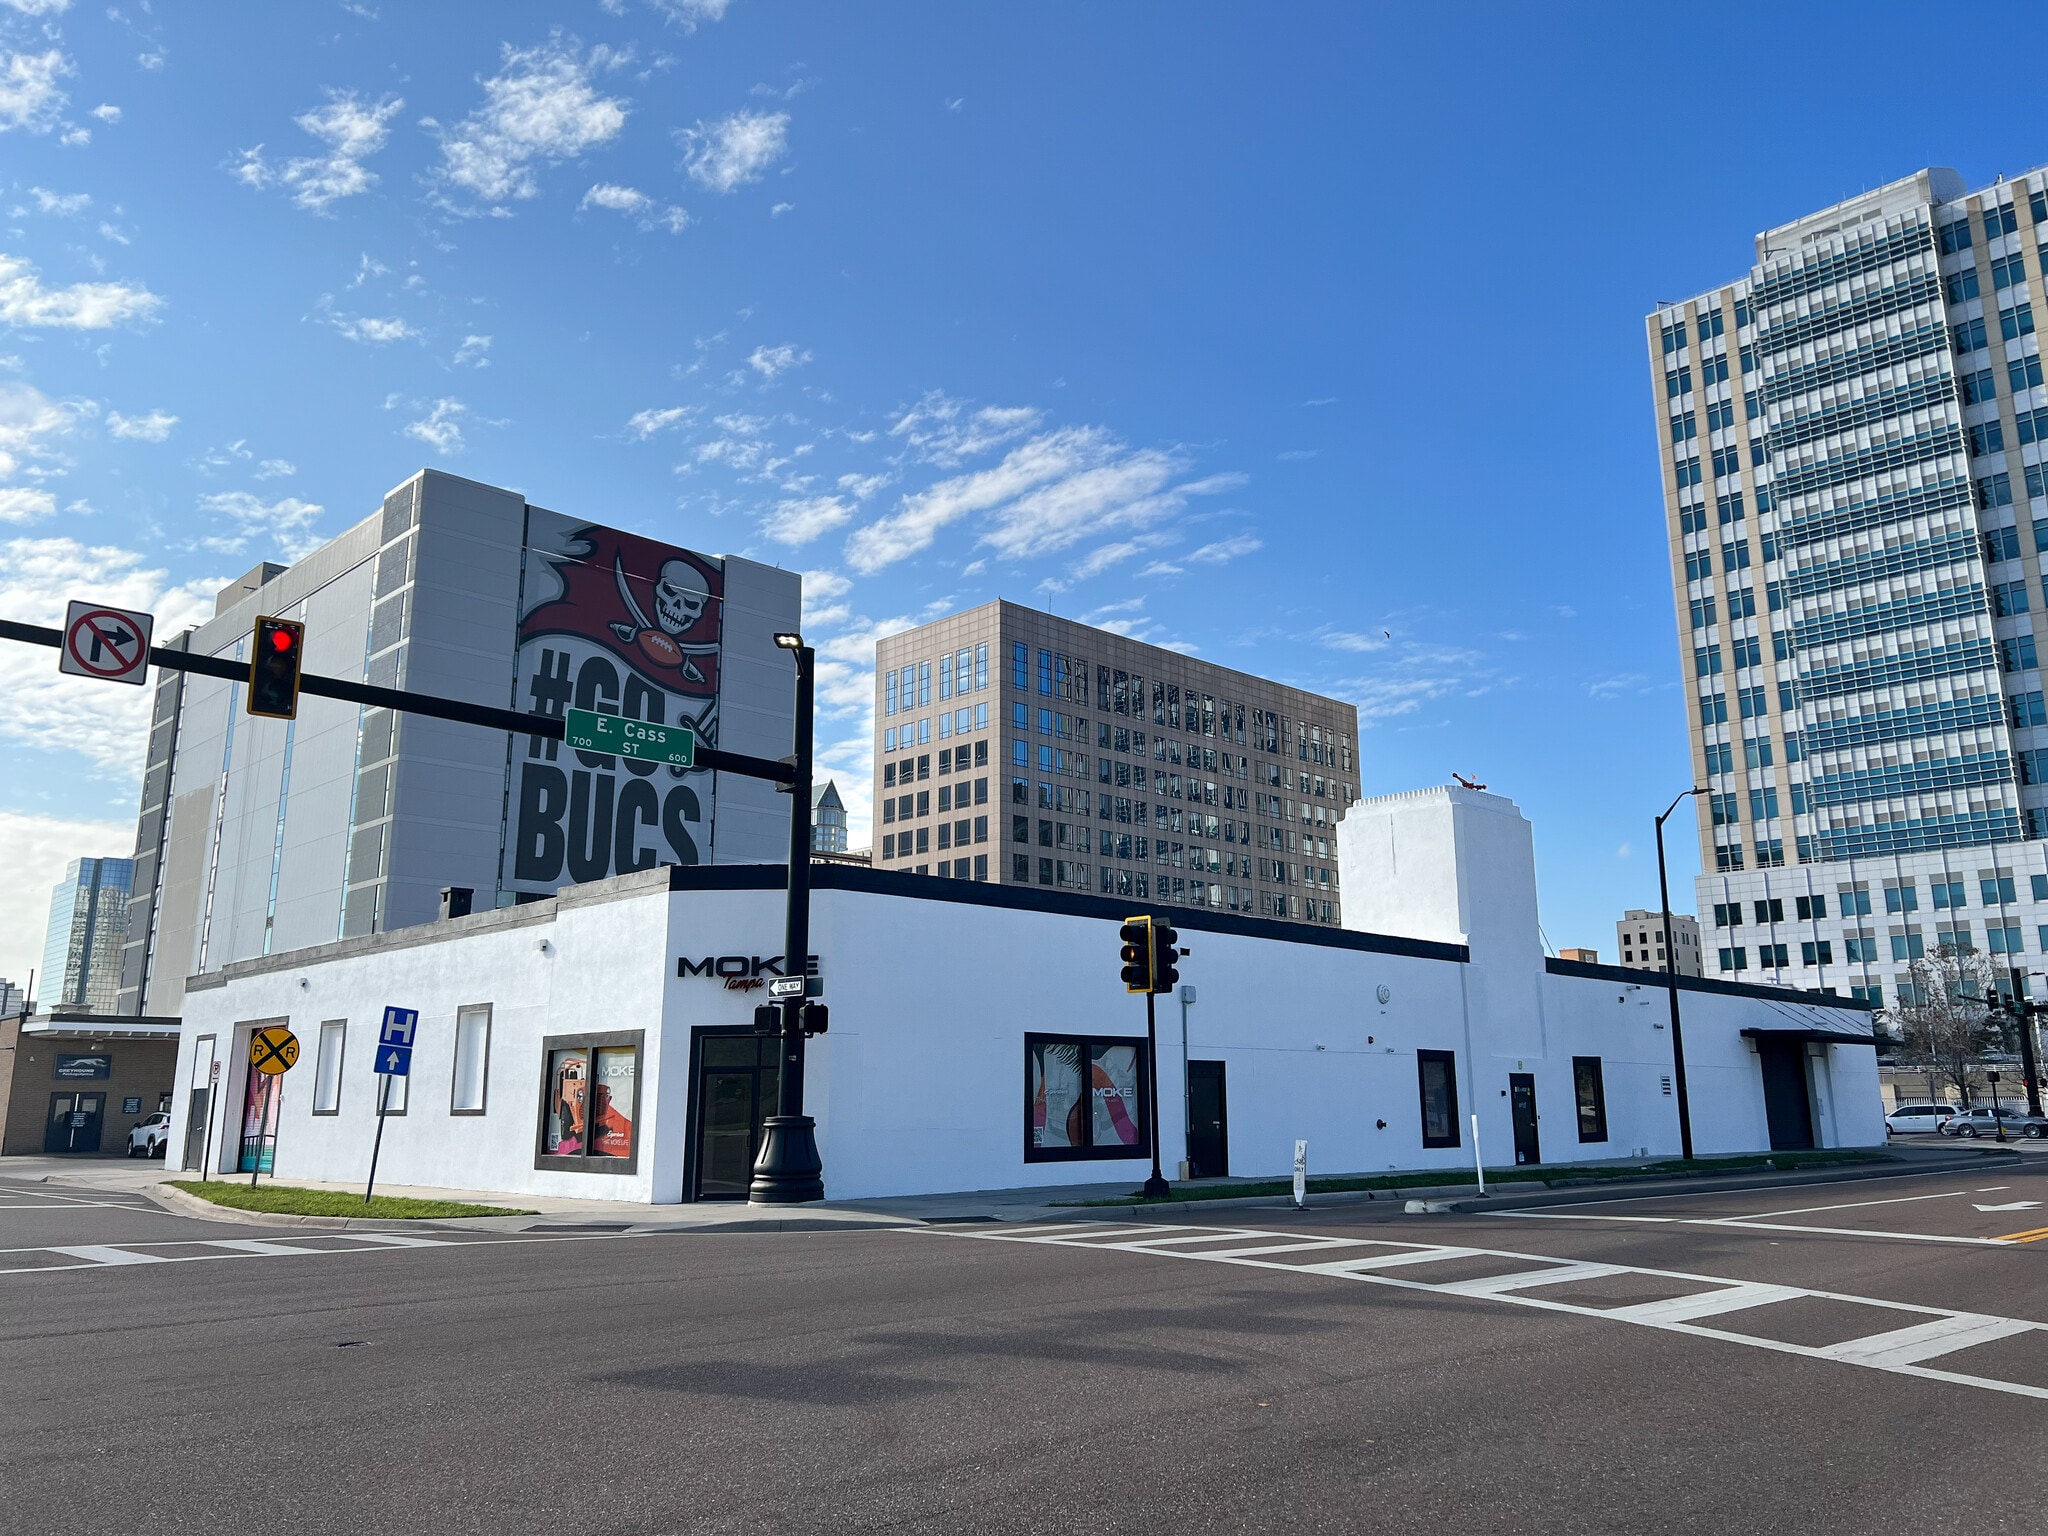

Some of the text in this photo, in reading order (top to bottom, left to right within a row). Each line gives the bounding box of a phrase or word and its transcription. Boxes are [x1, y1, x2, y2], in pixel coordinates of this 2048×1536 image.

[596, 717, 666, 743] E. Cass
[572, 736, 687, 763] 700 ST 600
[514, 762, 701, 885] BUCS
[722, 971, 765, 993] Tampa
[778, 983, 788, 991] ONE
[383, 1010, 415, 1044] H
[253, 1044, 296, 1058] R R
[602, 1065, 635, 1077] MOKE
[1092, 1087, 1133, 1097] MOKE
